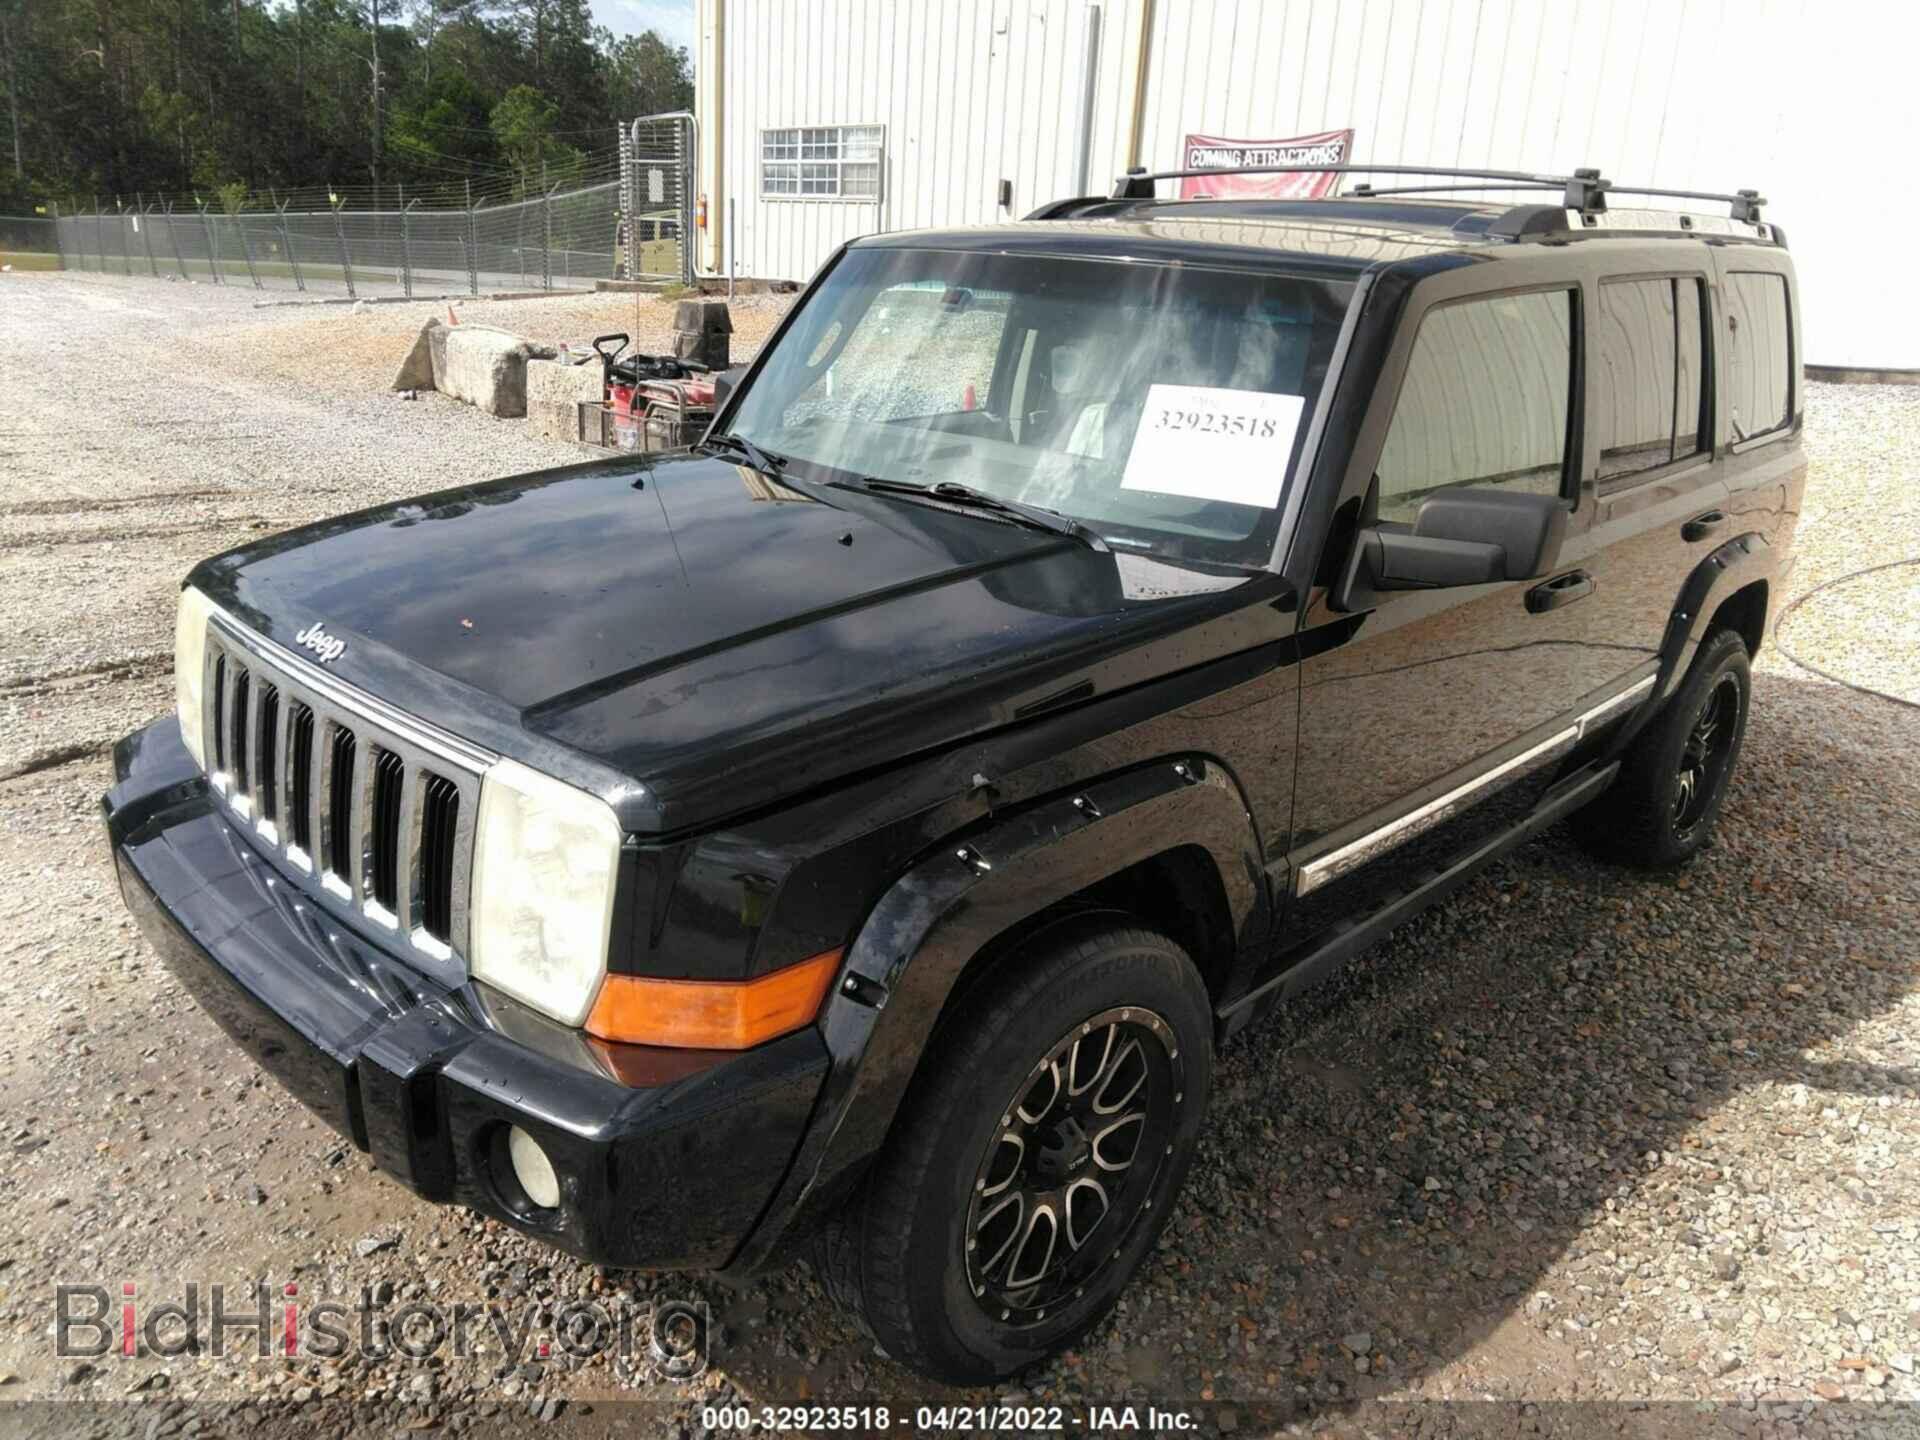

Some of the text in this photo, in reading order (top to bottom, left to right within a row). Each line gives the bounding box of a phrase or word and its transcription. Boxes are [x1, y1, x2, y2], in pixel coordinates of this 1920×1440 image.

[1190, 143, 1340, 167] COMING ATTRACTIONS
[1155, 410, 1277, 438] 32923518
[295, 621, 345, 662] Jeep
